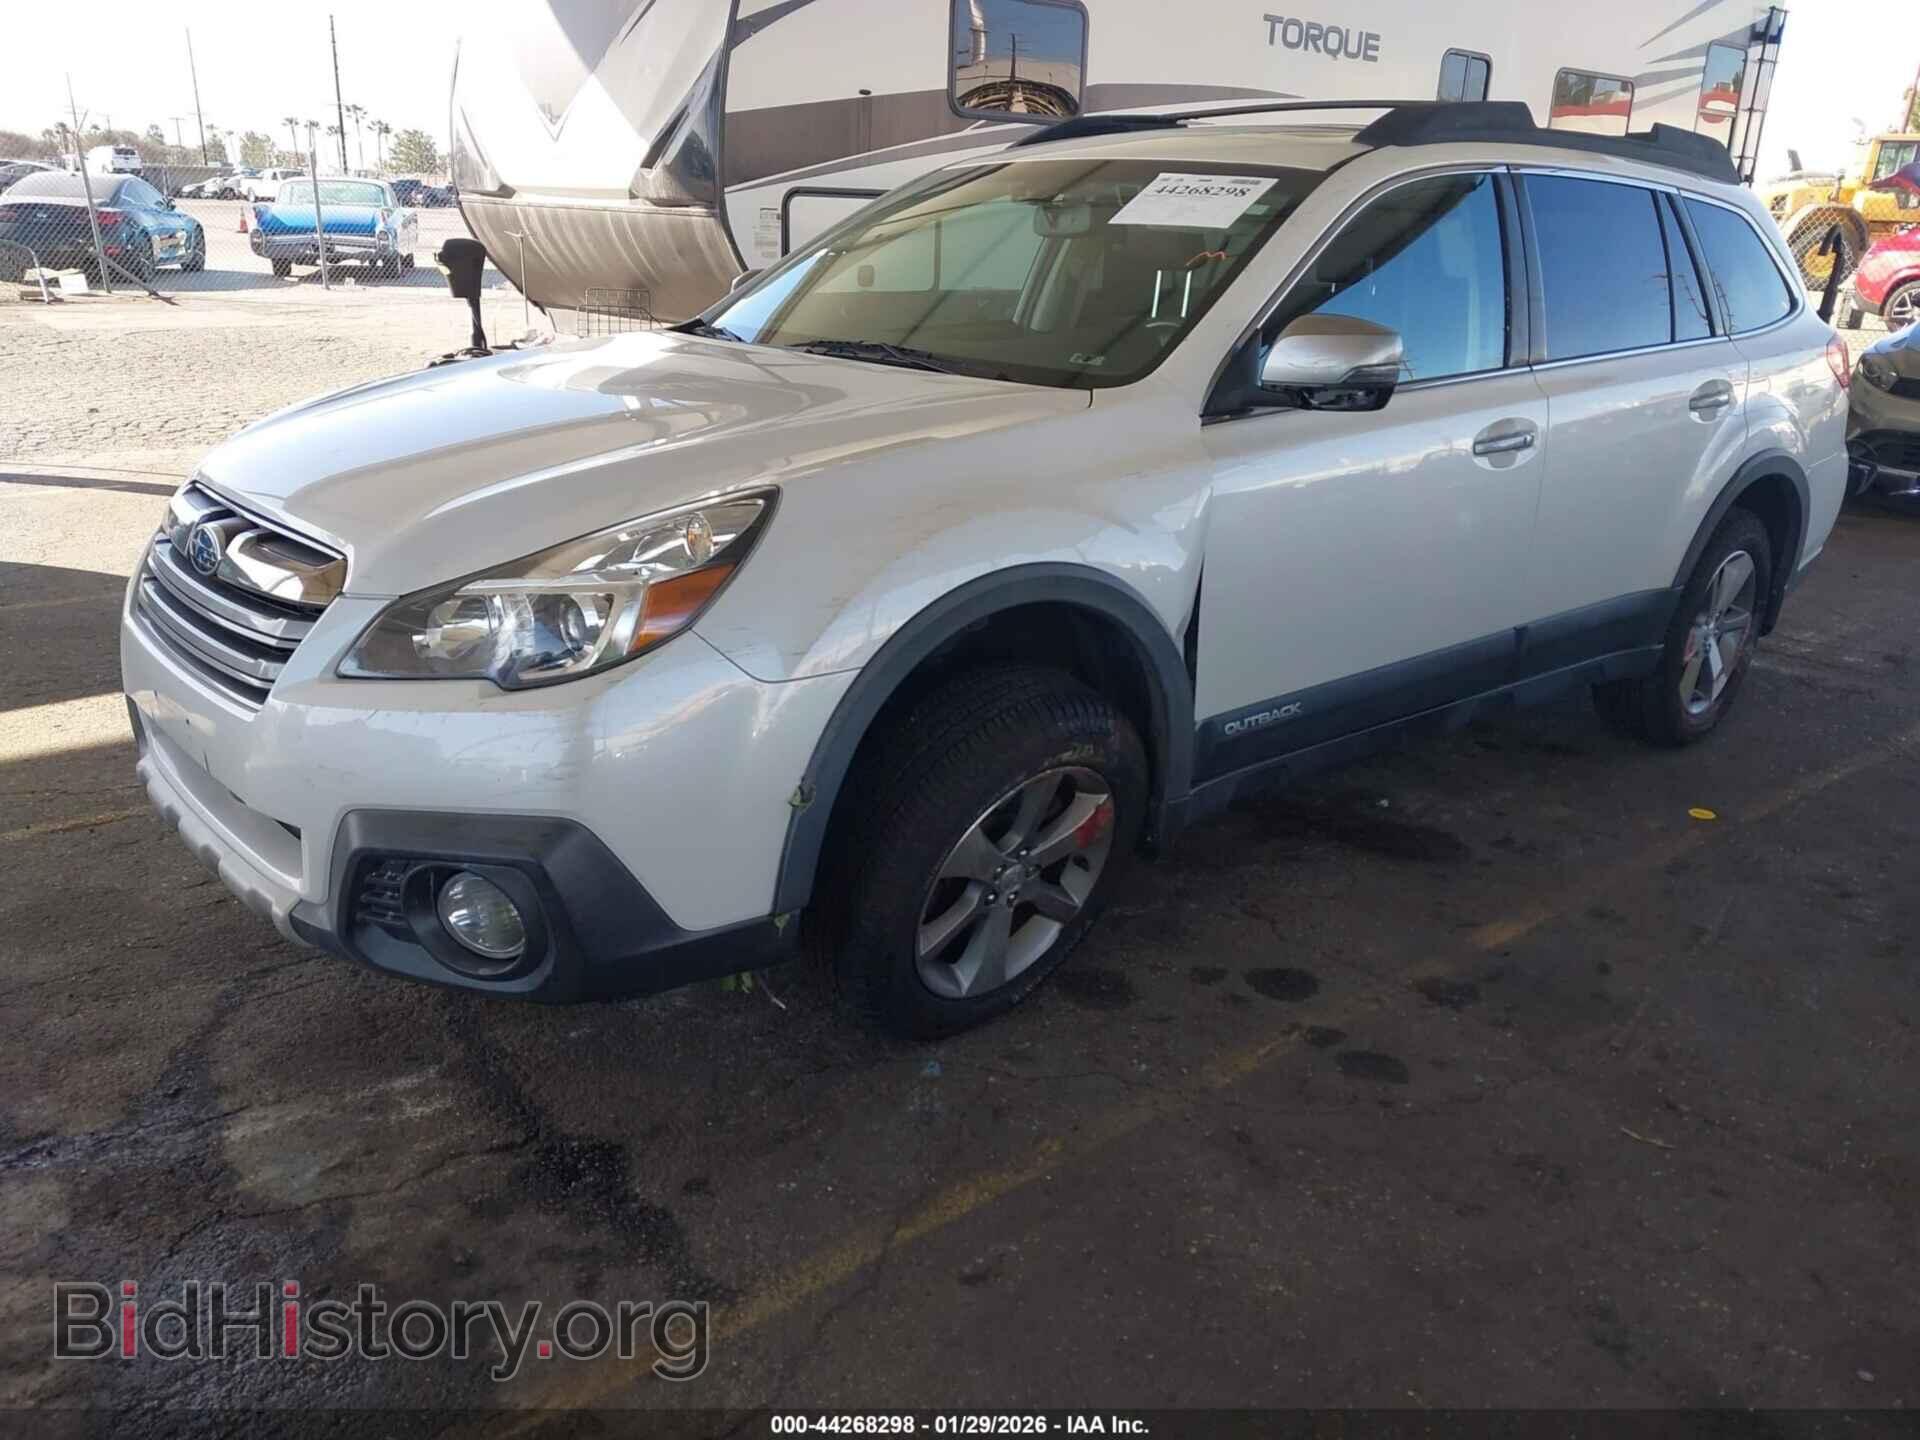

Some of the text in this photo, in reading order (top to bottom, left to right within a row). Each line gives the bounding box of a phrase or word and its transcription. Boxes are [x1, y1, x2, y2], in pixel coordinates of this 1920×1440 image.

[1263, 13, 1381, 63] TORQUE
[1155, 185, 1251, 197] 44268298
[1224, 702, 1302, 735] OUTBACK
